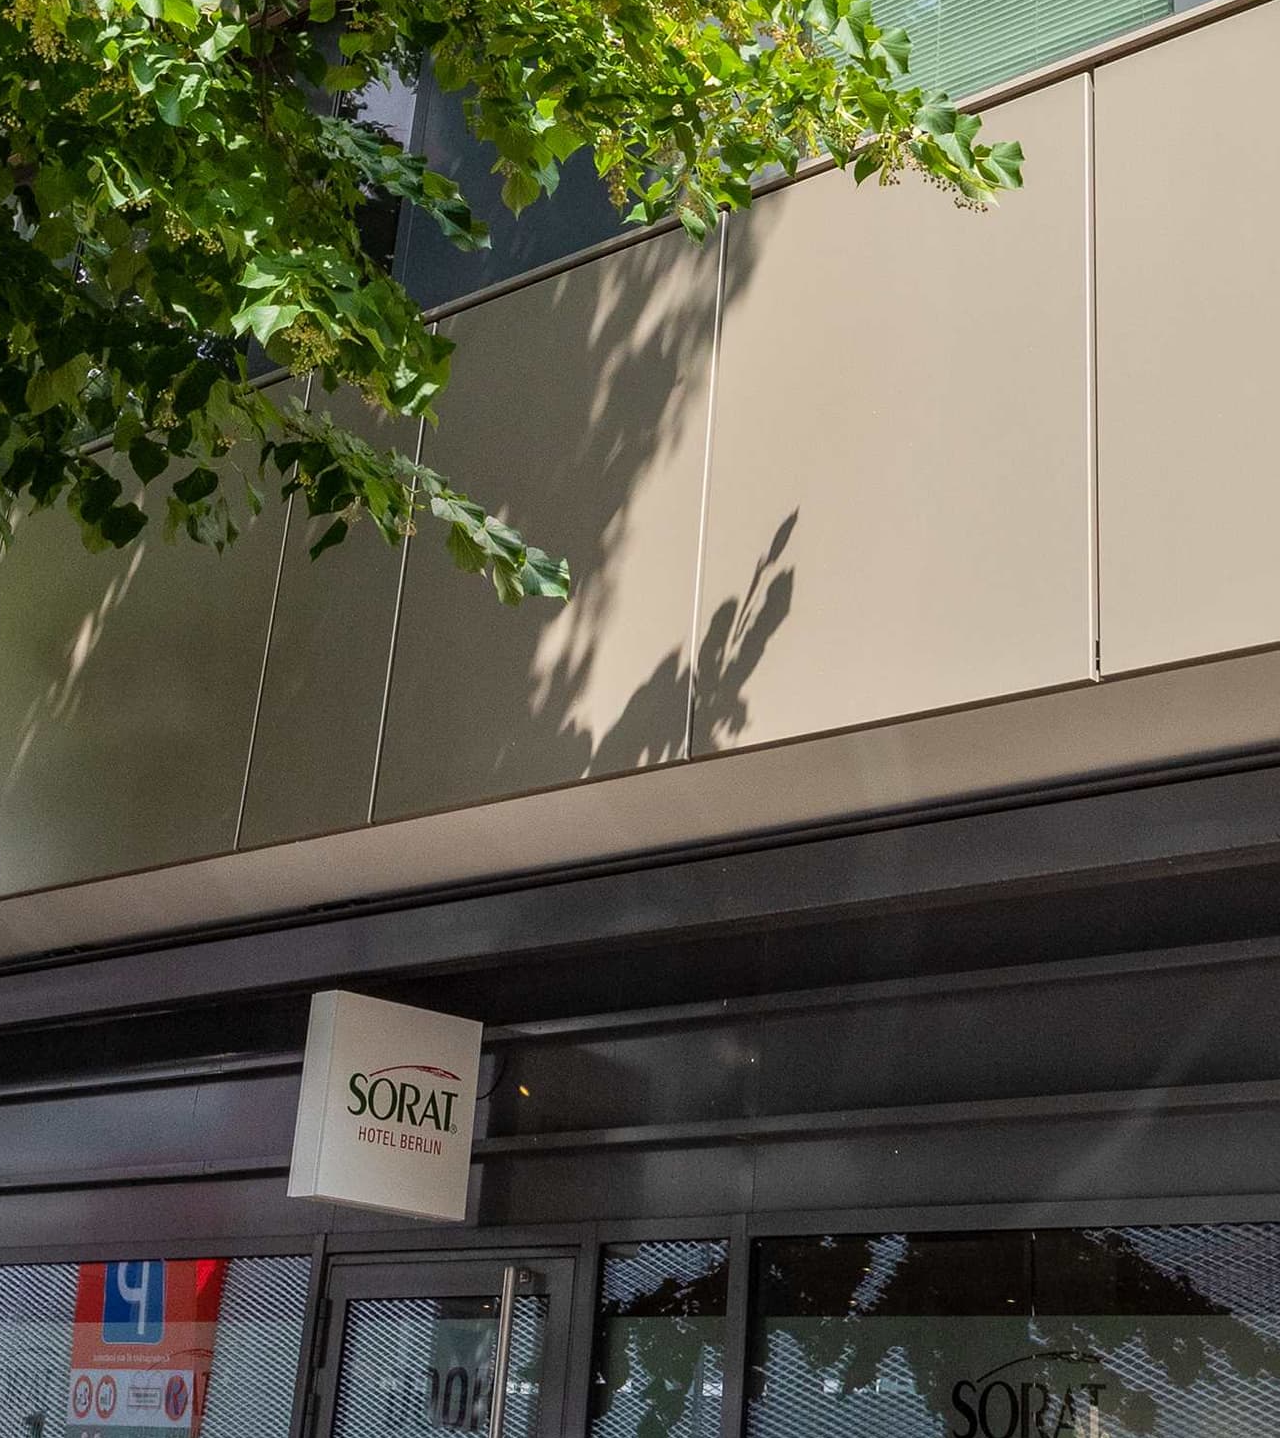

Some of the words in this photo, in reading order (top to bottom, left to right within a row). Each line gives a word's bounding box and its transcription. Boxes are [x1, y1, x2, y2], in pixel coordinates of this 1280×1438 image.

[347, 1072, 459, 1132] SORAT
[357, 1125, 396, 1147] HOTEL
[399, 1134, 442, 1156] BERLIN
